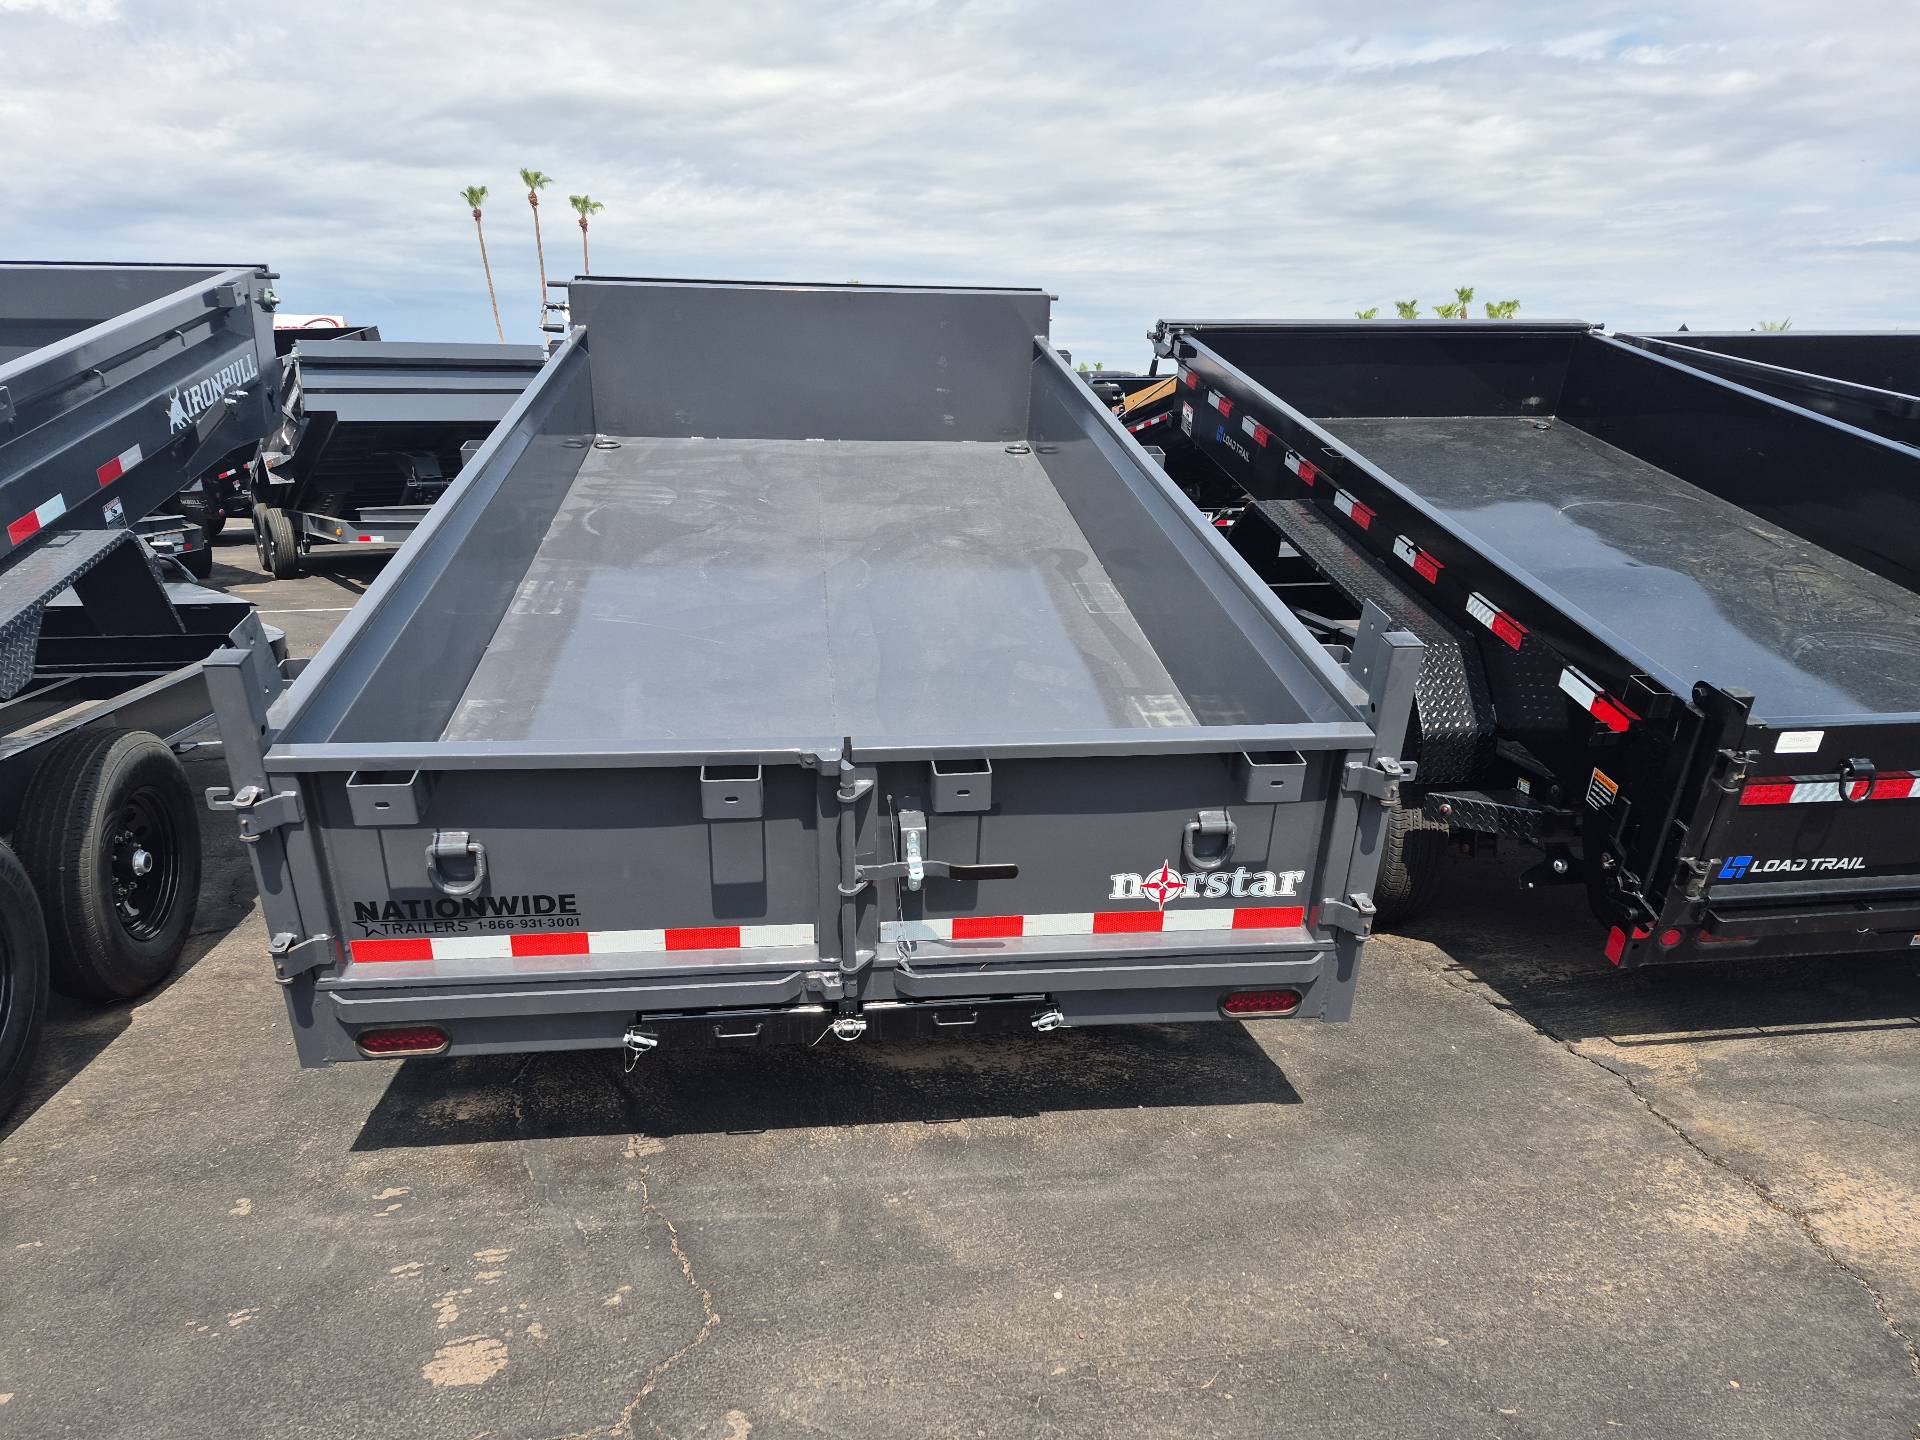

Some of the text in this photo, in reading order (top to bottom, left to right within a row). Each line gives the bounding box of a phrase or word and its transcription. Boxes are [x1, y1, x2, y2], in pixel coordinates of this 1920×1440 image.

[183, 353, 258, 418] IRONBULL
[1750, 858, 1807, 873] LOAD
[1810, 856, 1866, 871] TRAIL
[1109, 864, 1305, 906] norstar
[352, 894, 578, 921] NATIONWIDE
[380, 917, 581, 935] TRAILERS 1-866-931-3001
